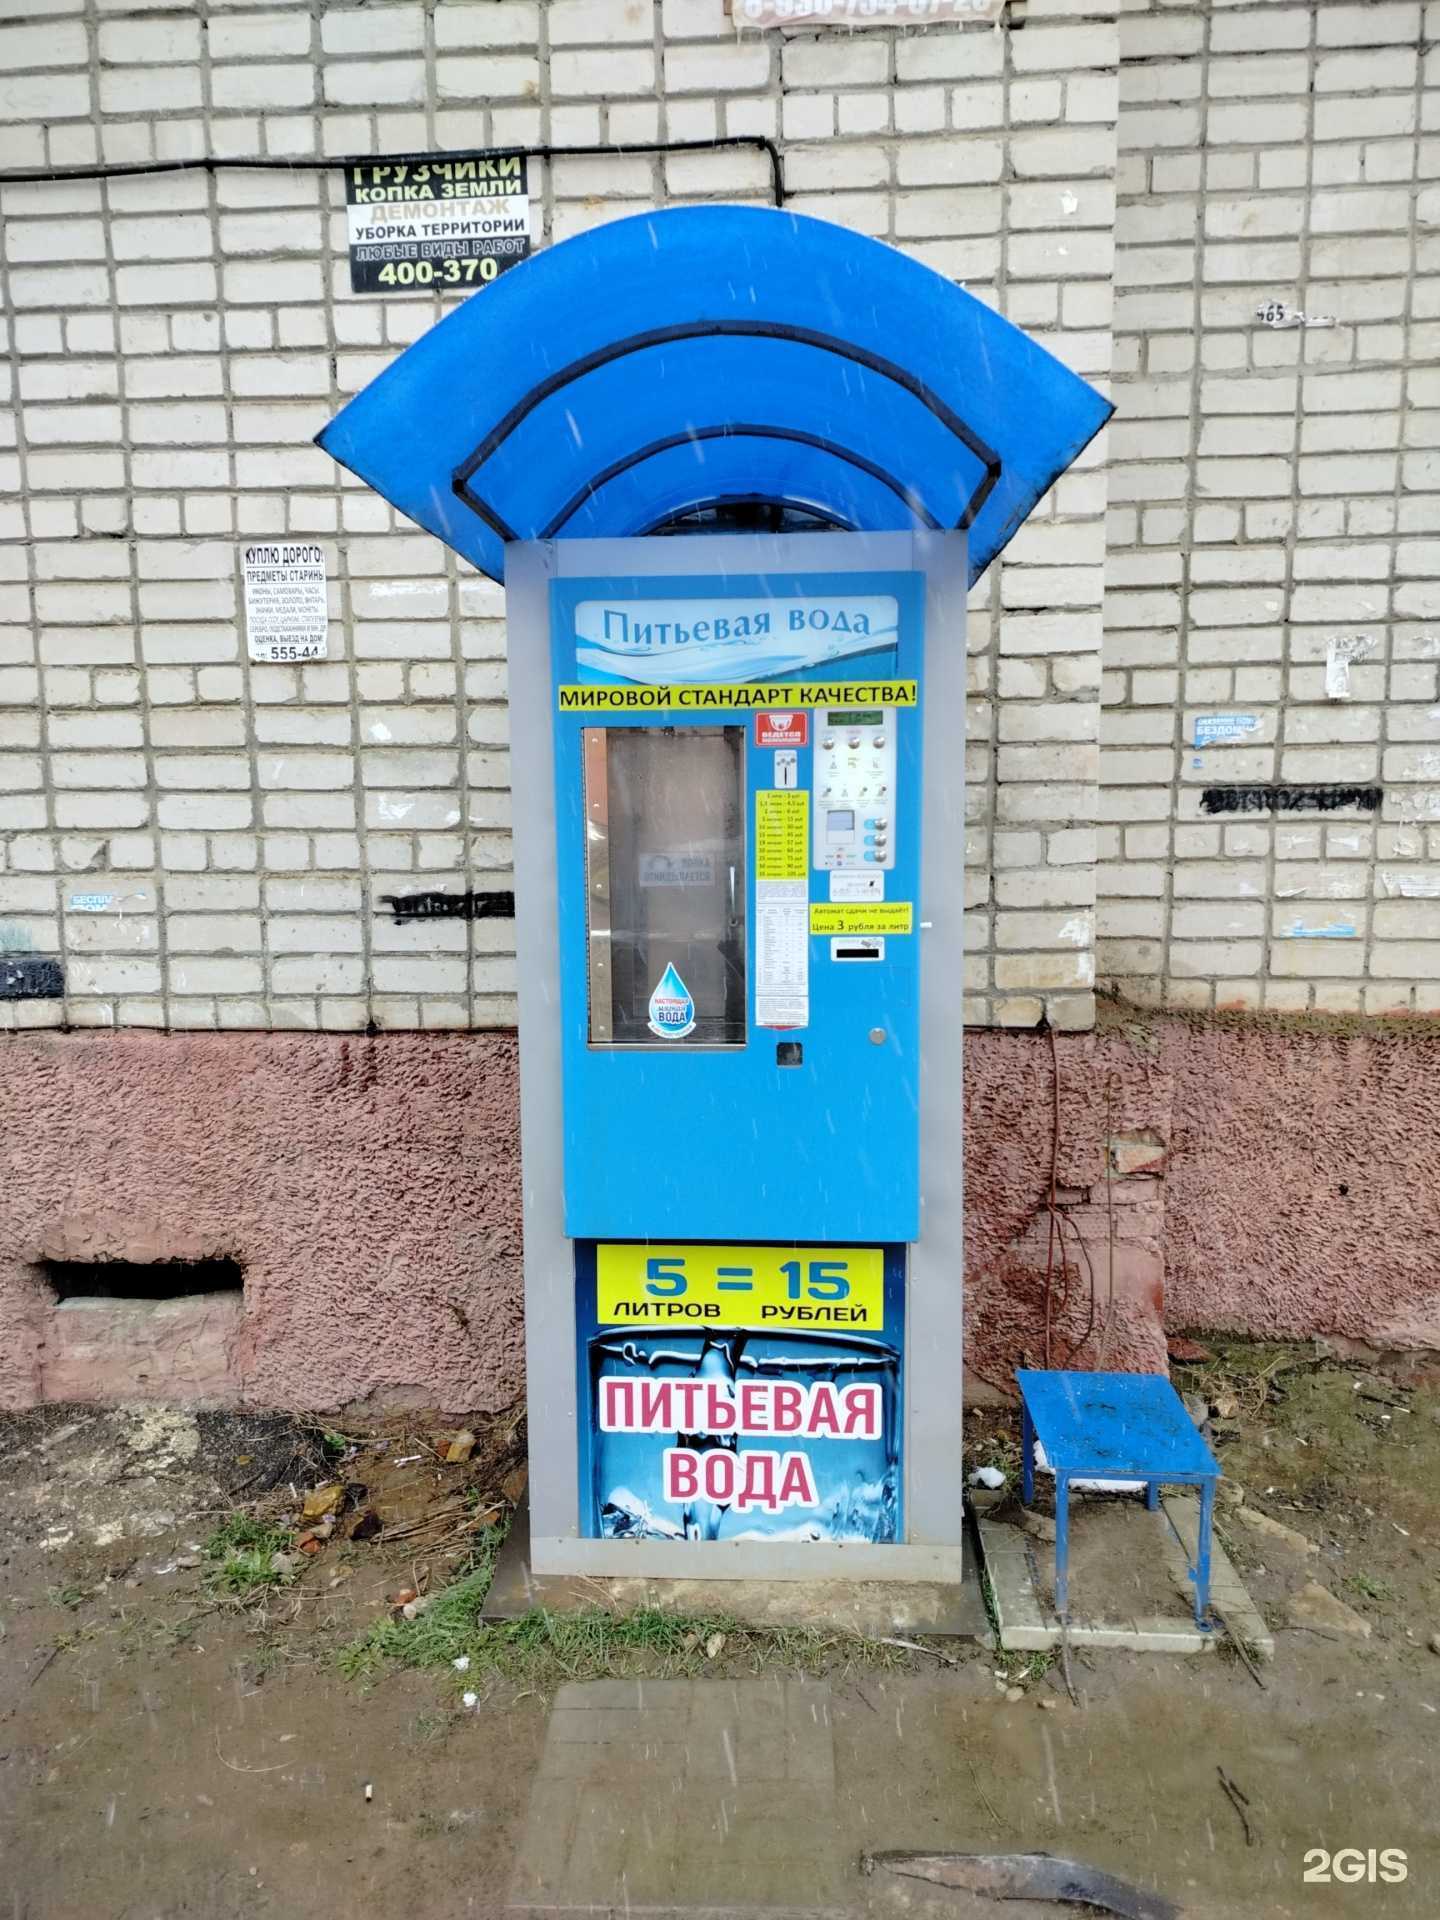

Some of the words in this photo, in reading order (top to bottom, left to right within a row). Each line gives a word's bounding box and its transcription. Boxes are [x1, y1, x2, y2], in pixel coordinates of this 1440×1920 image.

[353, 156, 521, 185] ГРУЗЧИКИ
[355, 185, 434, 203] КОПКА
[441, 180, 521, 198] ЗЕМЛИ
[371, 198, 511, 224] ДЕМОНТАЖ
[356, 224, 417, 240] УБОРКА
[421, 219, 525, 236] ТЕРРИТОРИИ
[356, 243, 417, 261] ЛЮБЫЕ
[421, 240, 469, 259] ВИДЫ
[472, 238, 525, 255] РАБОТ
[378, 257, 498, 285] 400-370
[246, 547, 279, 564] КУПЛЮ
[246, 570, 288, 584] ПРЕДМЕТЫ
[603, 608, 771, 646] Питьевая
[788, 608, 871, 635] вода
[560, 685, 671, 707] МИРОВОЙ
[679, 686, 791, 707] СТАНДАРТ
[800, 684, 917, 704] КАЧЕСТВА!
[812, 922, 835, 933] Цена
[837, 919, 845, 930] 3
[659, 1011, 685, 1023] ВОДА
[646, 1258, 688, 1297] 5
[779, 1260, 850, 1300] 15
[613, 1302, 721, 1318] ЛИТРОВ
[761, 1303, 867, 1322] РУБЛЕЙ
[605, 1381, 876, 1435] ПИТЬЕВАЯ
[669, 1452, 813, 1509] ВОДА
